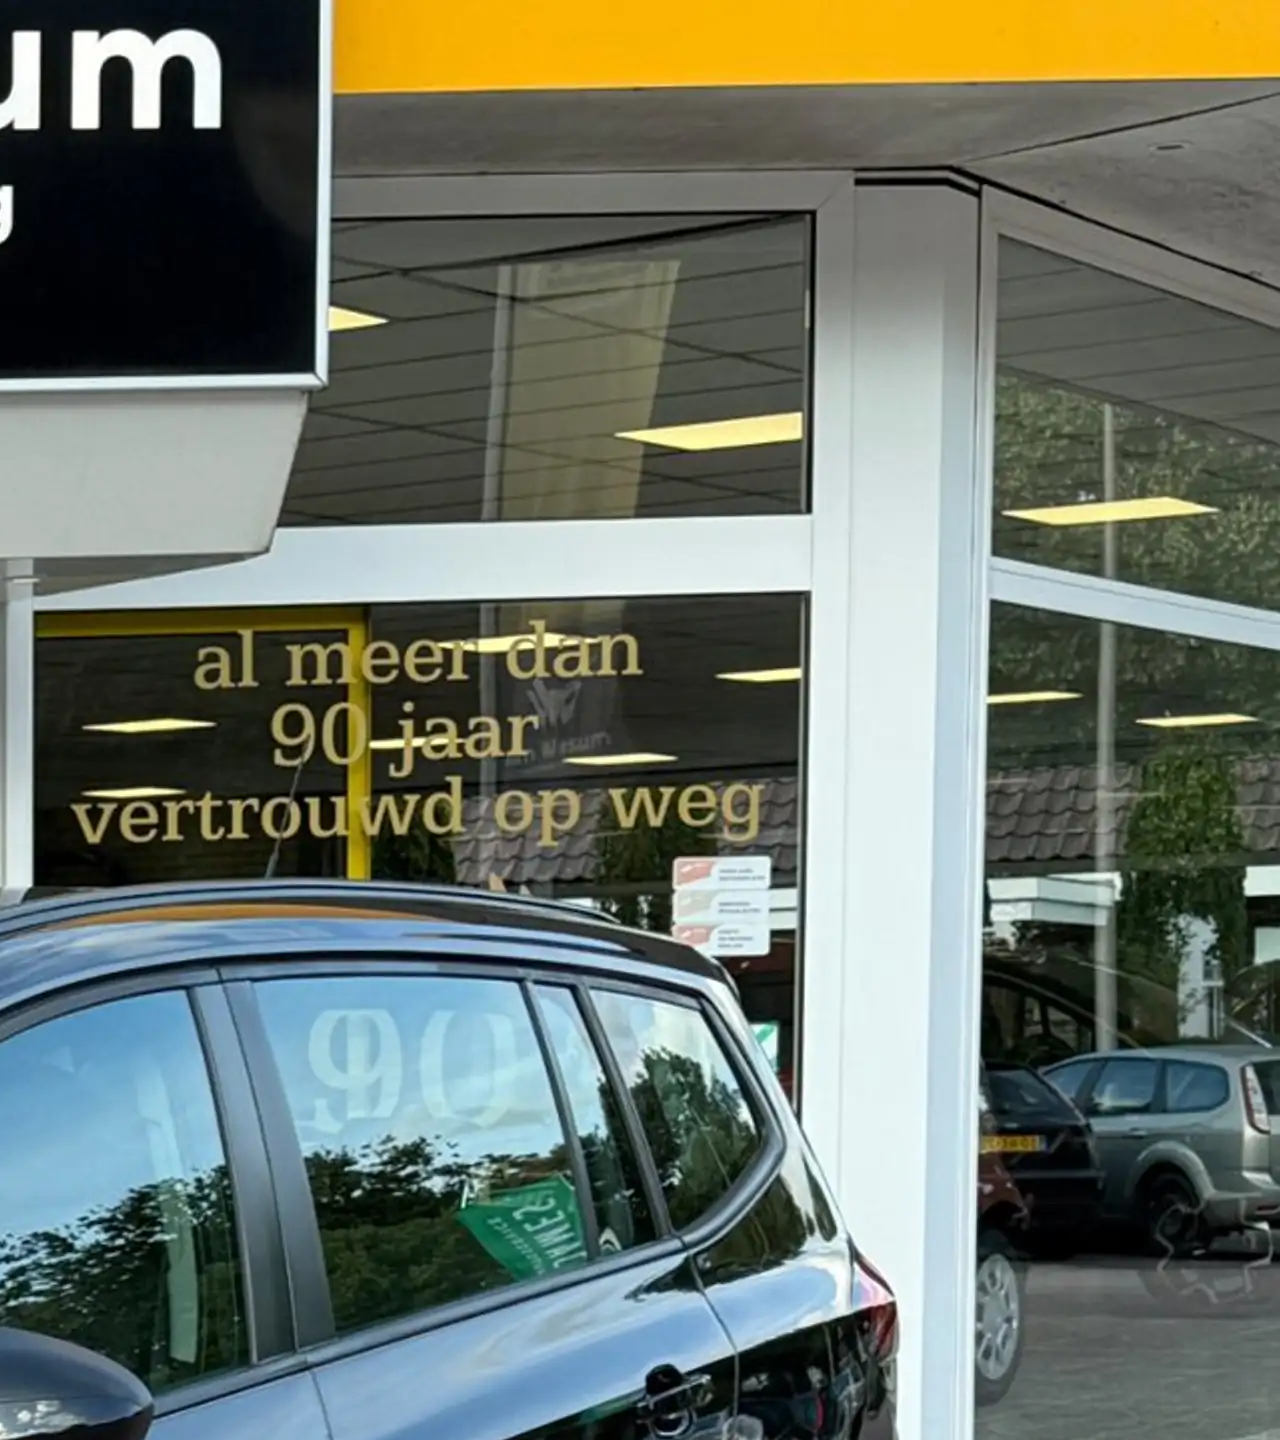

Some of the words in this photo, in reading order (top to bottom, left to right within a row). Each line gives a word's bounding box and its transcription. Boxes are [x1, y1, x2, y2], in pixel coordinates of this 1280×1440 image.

[193, 628, 259, 690] al
[285, 636, 478, 688] meer
[505, 619, 643, 680] dan
[271, 701, 368, 769] 90
[390, 701, 540, 778] jaar
[72, 776, 465, 846] vertrouwd
[494, 787, 581, 847] op
[609, 782, 765, 841] weg
